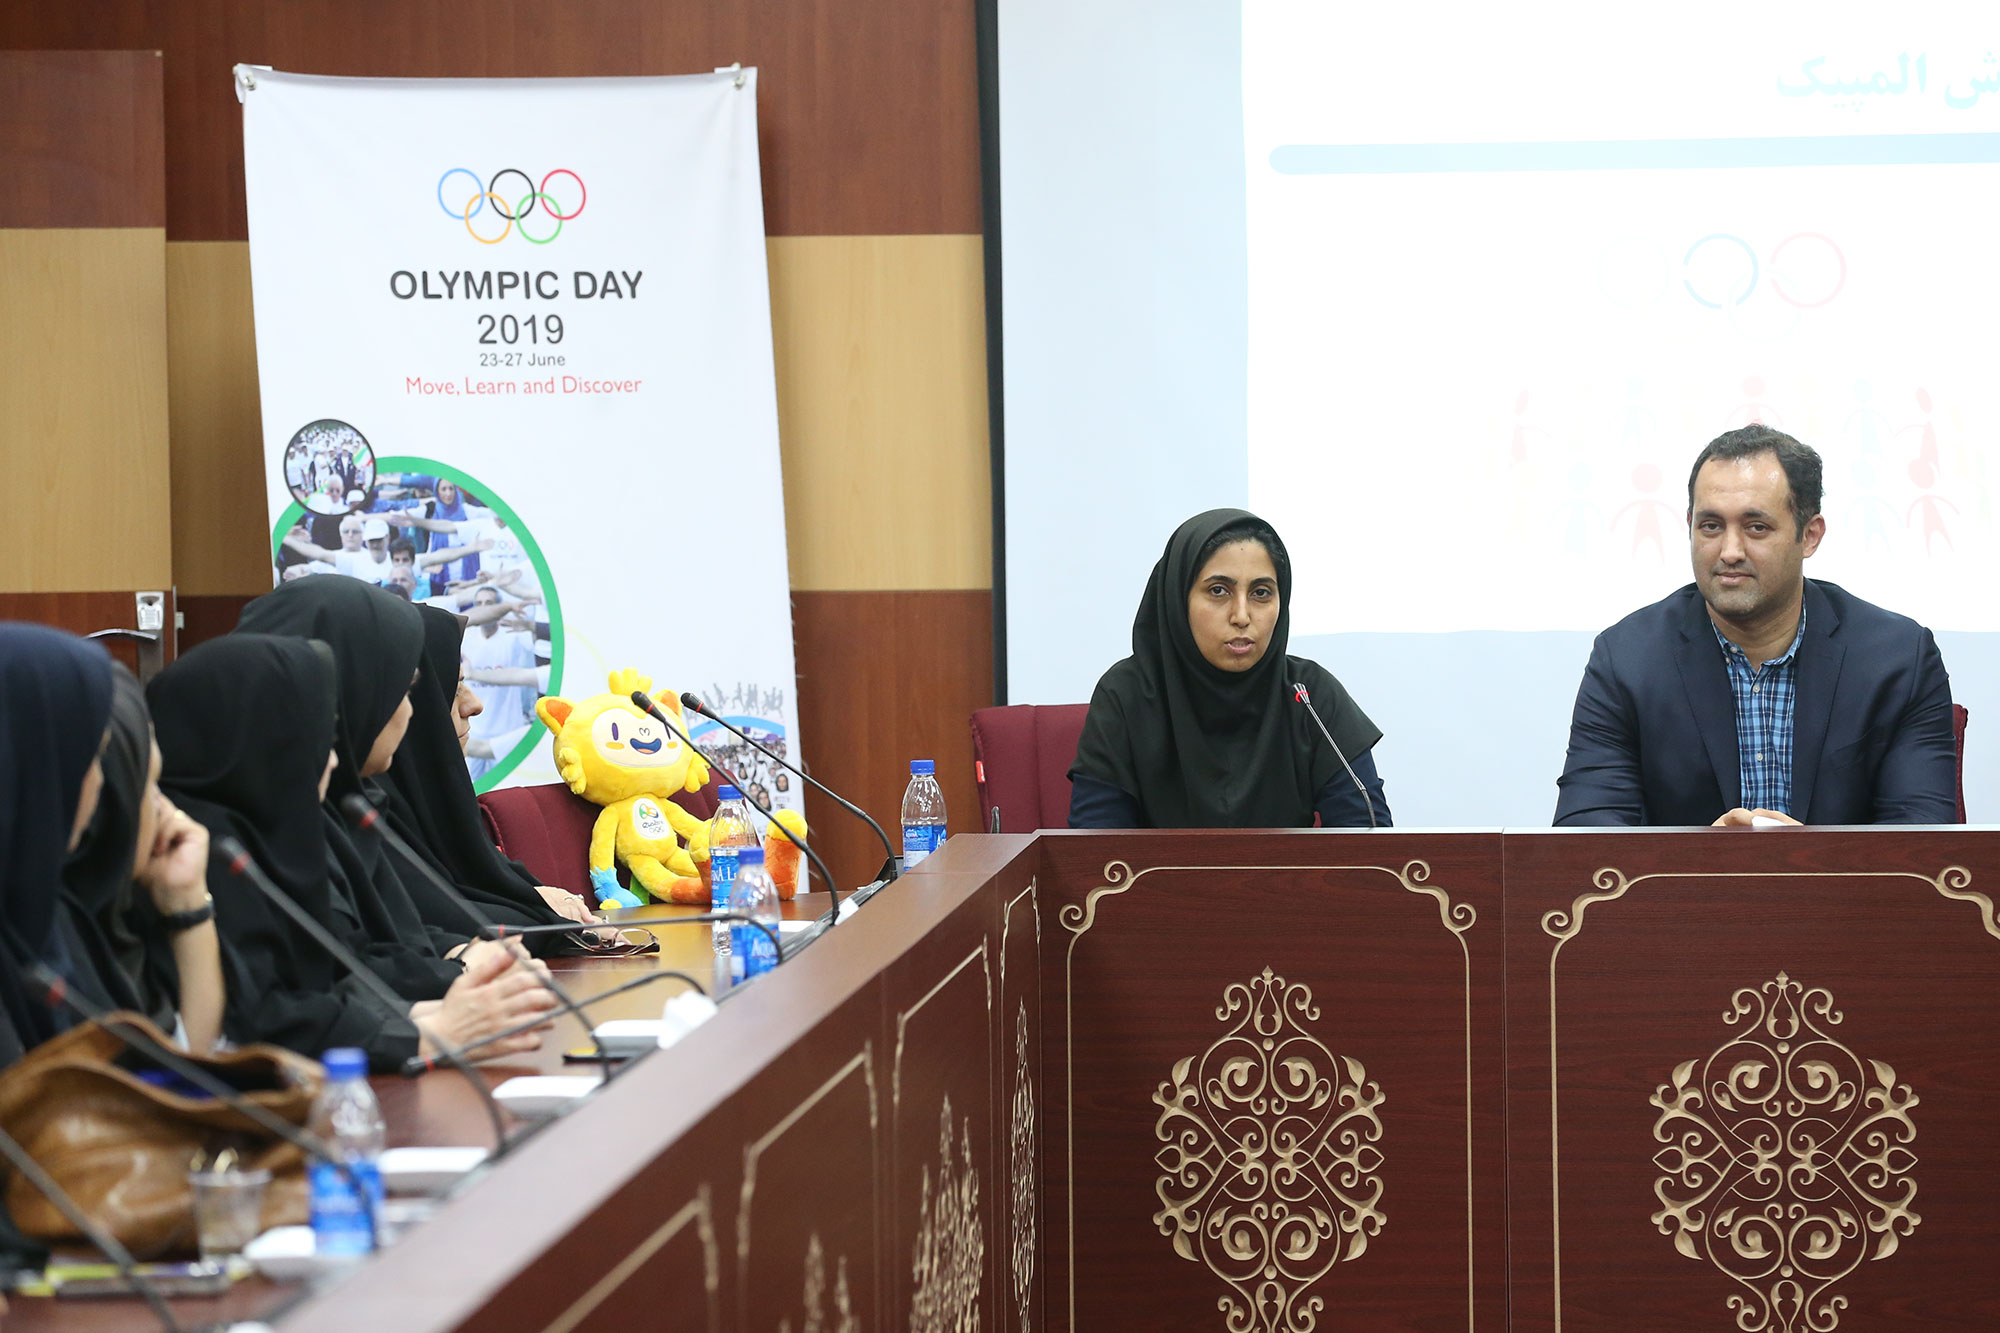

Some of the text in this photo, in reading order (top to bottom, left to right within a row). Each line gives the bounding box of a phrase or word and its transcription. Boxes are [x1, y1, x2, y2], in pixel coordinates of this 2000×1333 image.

[1777, 51, 1927, 113] المپیک
[390, 270, 643, 300] OLYMPIC DAY
[477, 314, 564, 345] 2019
[479, 353, 566, 367] 23-27 June
[405, 375, 642, 396] Move, Learn and Discover
